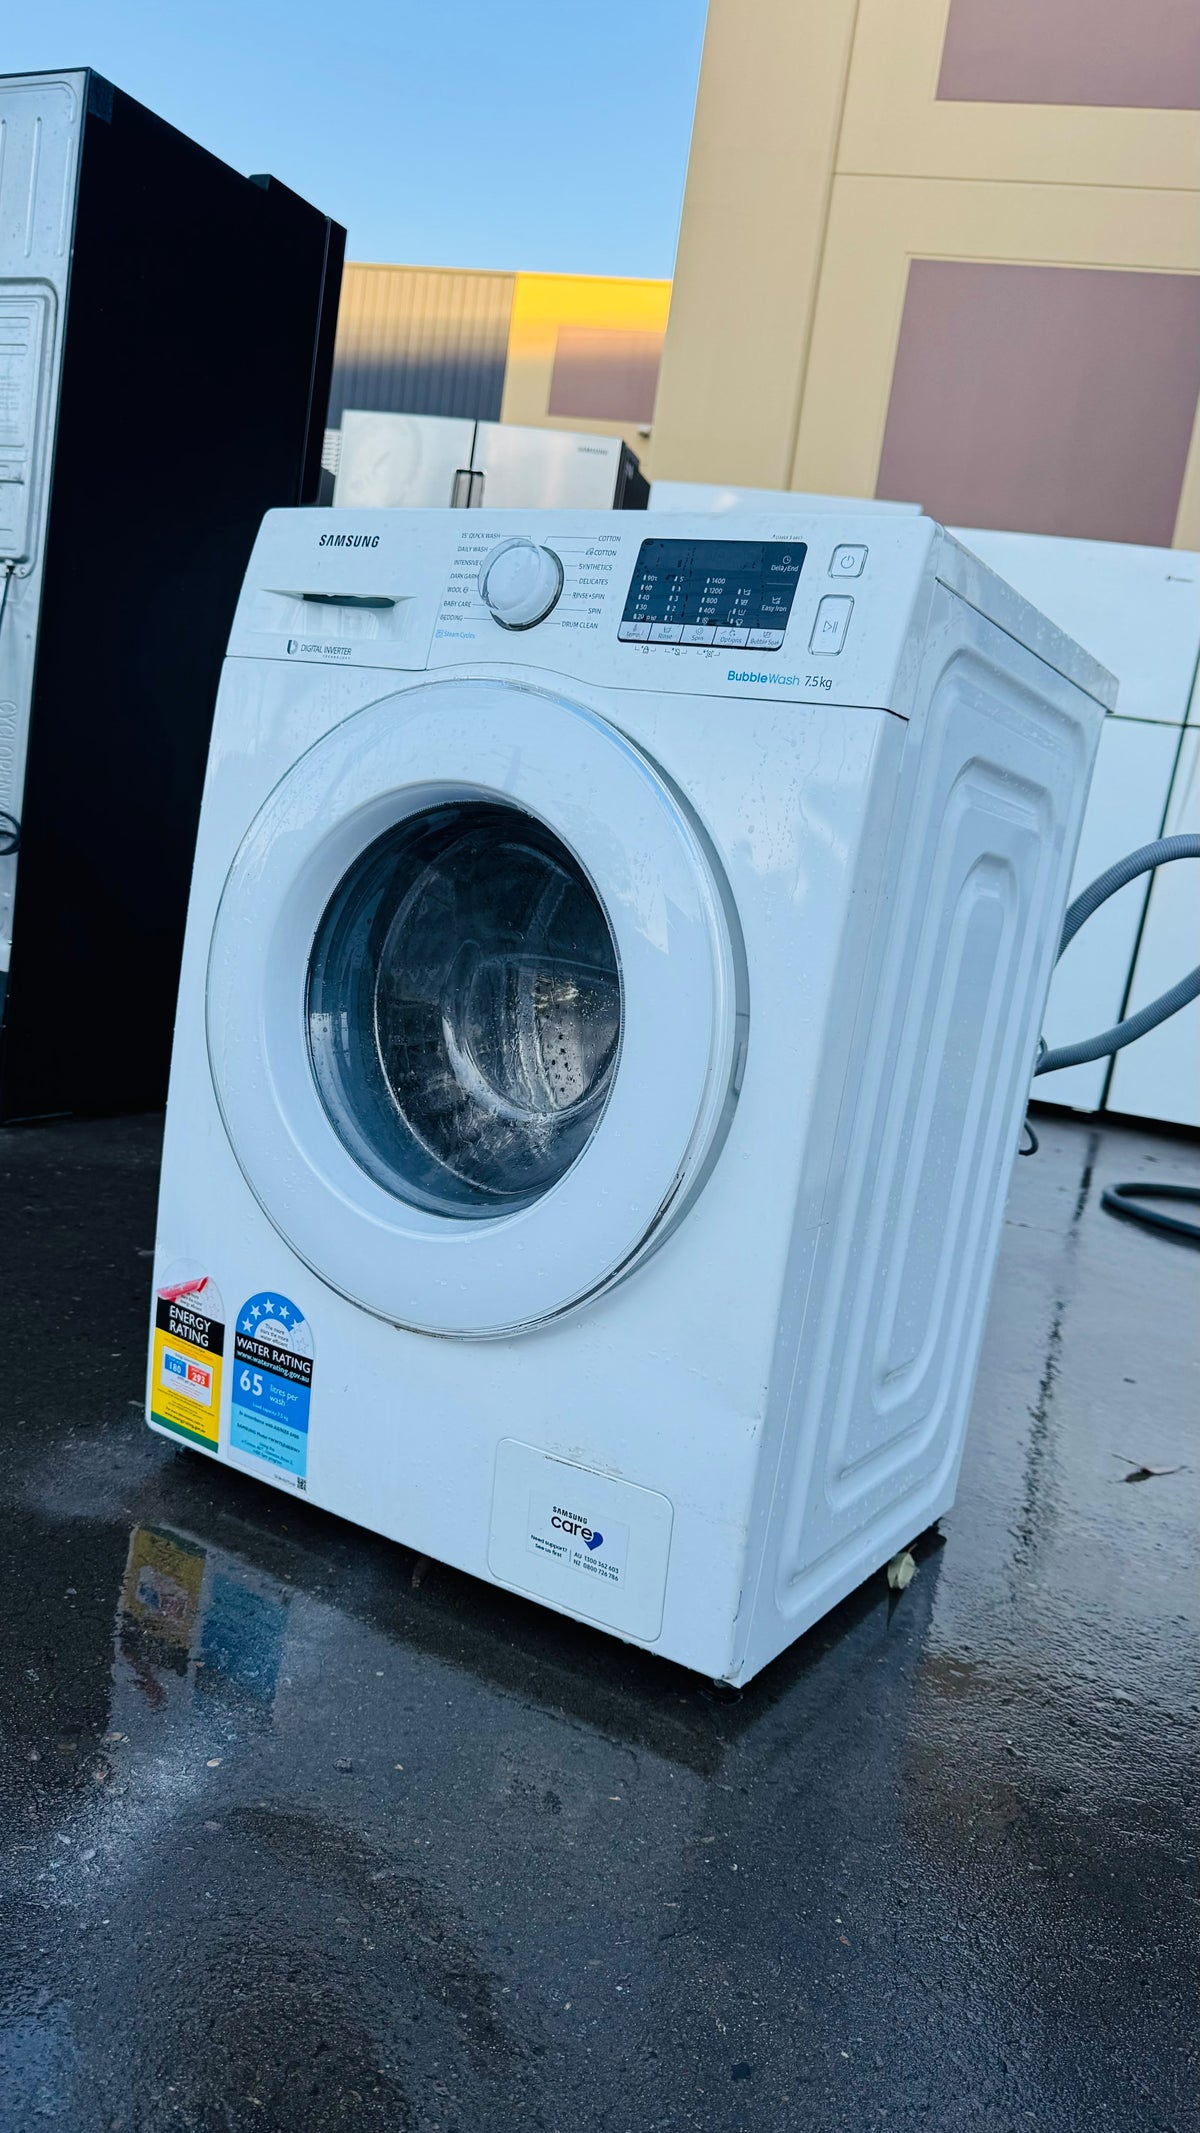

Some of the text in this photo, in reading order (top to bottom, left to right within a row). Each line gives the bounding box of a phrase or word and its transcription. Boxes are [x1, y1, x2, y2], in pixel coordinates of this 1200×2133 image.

[319, 535, 380, 548] SAMSUNG
[301, 644, 352, 656] DIGITAL INVERTER
[727, 670, 800, 686] BubbleWash
[170, 1305, 211, 1332] ENERGY
[169, 1319, 209, 1347] RATING
[237, 1336, 270, 1358] WATER
[272, 1350, 311, 1374] RATING
[169, 1361, 181, 1374] 180
[236, 1350, 310, 1383] www.waterrating.gov.au
[192, 1372, 206, 1385] 293
[240, 1369, 263, 1396] 65
[269, 1395, 286, 1407] wash
[270, 1384, 298, 1402] litres per
[552, 1506, 588, 1524] SAMSUNG
[551, 1516, 592, 1540] care
[531, 1534, 568, 1552] Need support?
[584, 1555, 597, 1565] 1300
[583, 1562, 597, 1573] 0800
[598, 1568, 608, 1577] 726
